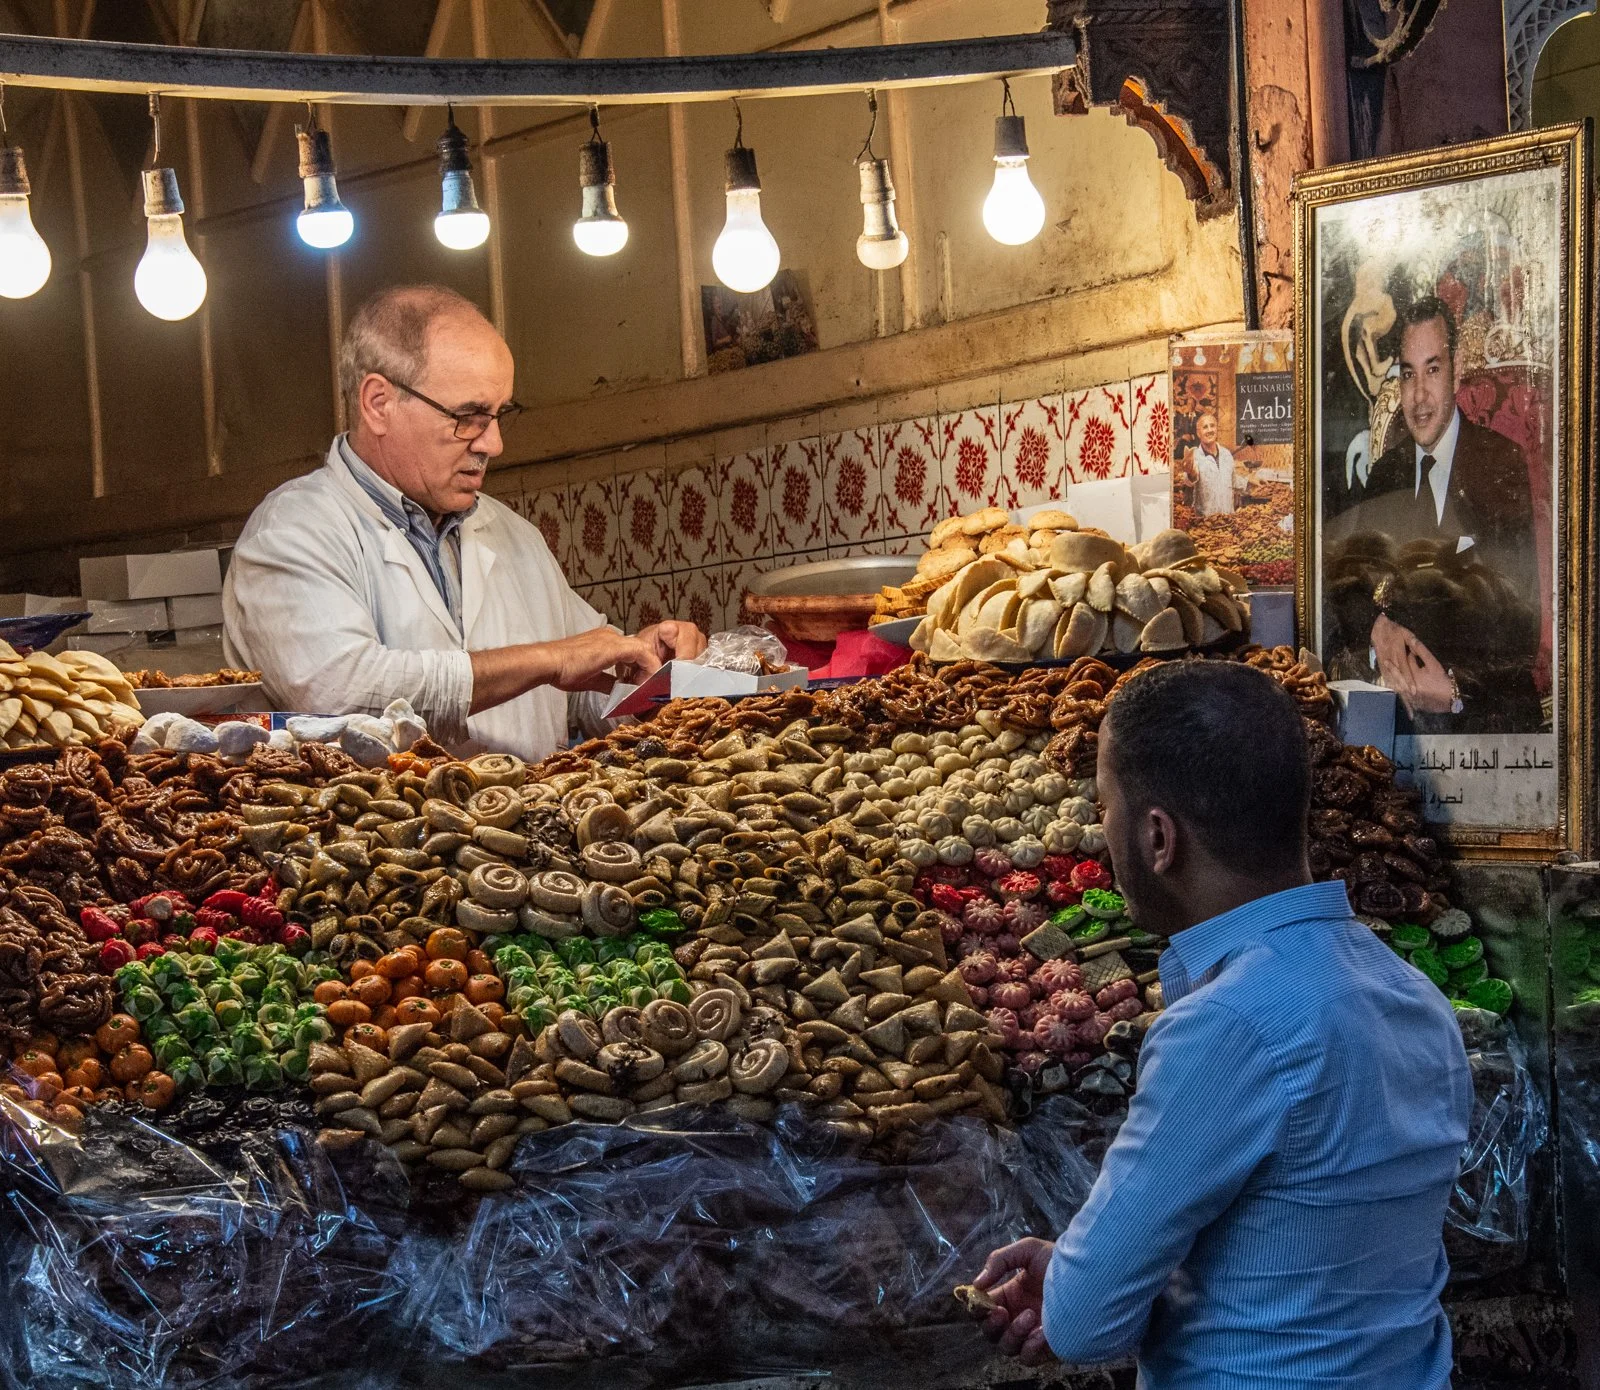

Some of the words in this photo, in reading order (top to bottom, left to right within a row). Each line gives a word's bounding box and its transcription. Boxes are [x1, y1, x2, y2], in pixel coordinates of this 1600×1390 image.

[1240, 396, 1292, 421] Arabi
[1419, 748, 1455, 775] الملك
[1459, 747, 1499, 775] الجلالة
[1503, 747, 1554, 775] صاحب
